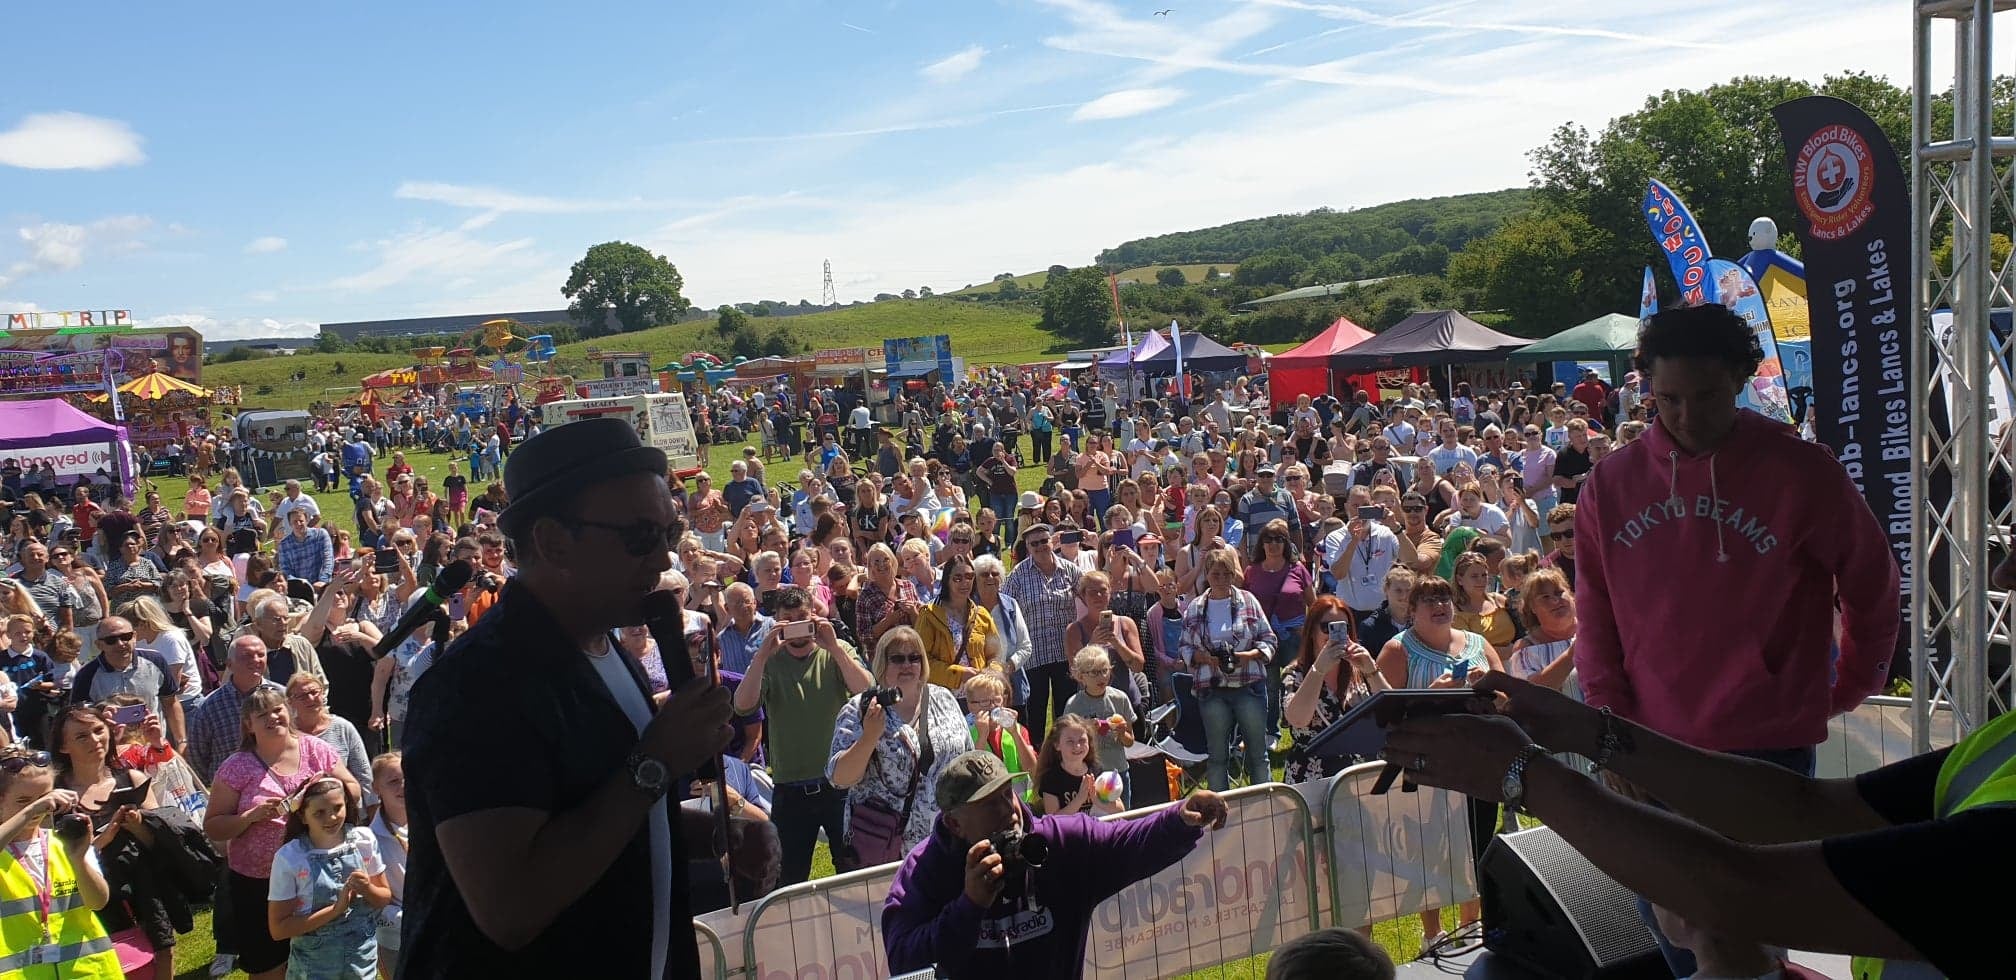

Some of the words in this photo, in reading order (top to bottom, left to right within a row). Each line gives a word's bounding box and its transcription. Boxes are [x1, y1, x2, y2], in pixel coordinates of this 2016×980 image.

[1795, 158, 1808, 187] NW
[1803, 126, 1838, 158] Blood
[1840, 128, 1867, 161] Bikes
[1813, 224, 1836, 239] Lancs
[1837, 226, 1846, 237] &
[1846, 205, 1872, 231] Lakes
[1865, 239, 1894, 305] Lakes
[58, 310, 127, 327] TRIP
[1871, 307, 1896, 326] &
[1876, 330, 1904, 394] Lancs
[1880, 399, 1912, 460] Bikes
[1613, 496, 1686, 549] TOKYO
[1695, 495, 1778, 555] BEAMS
[1884, 471, 1912, 534] Blood
